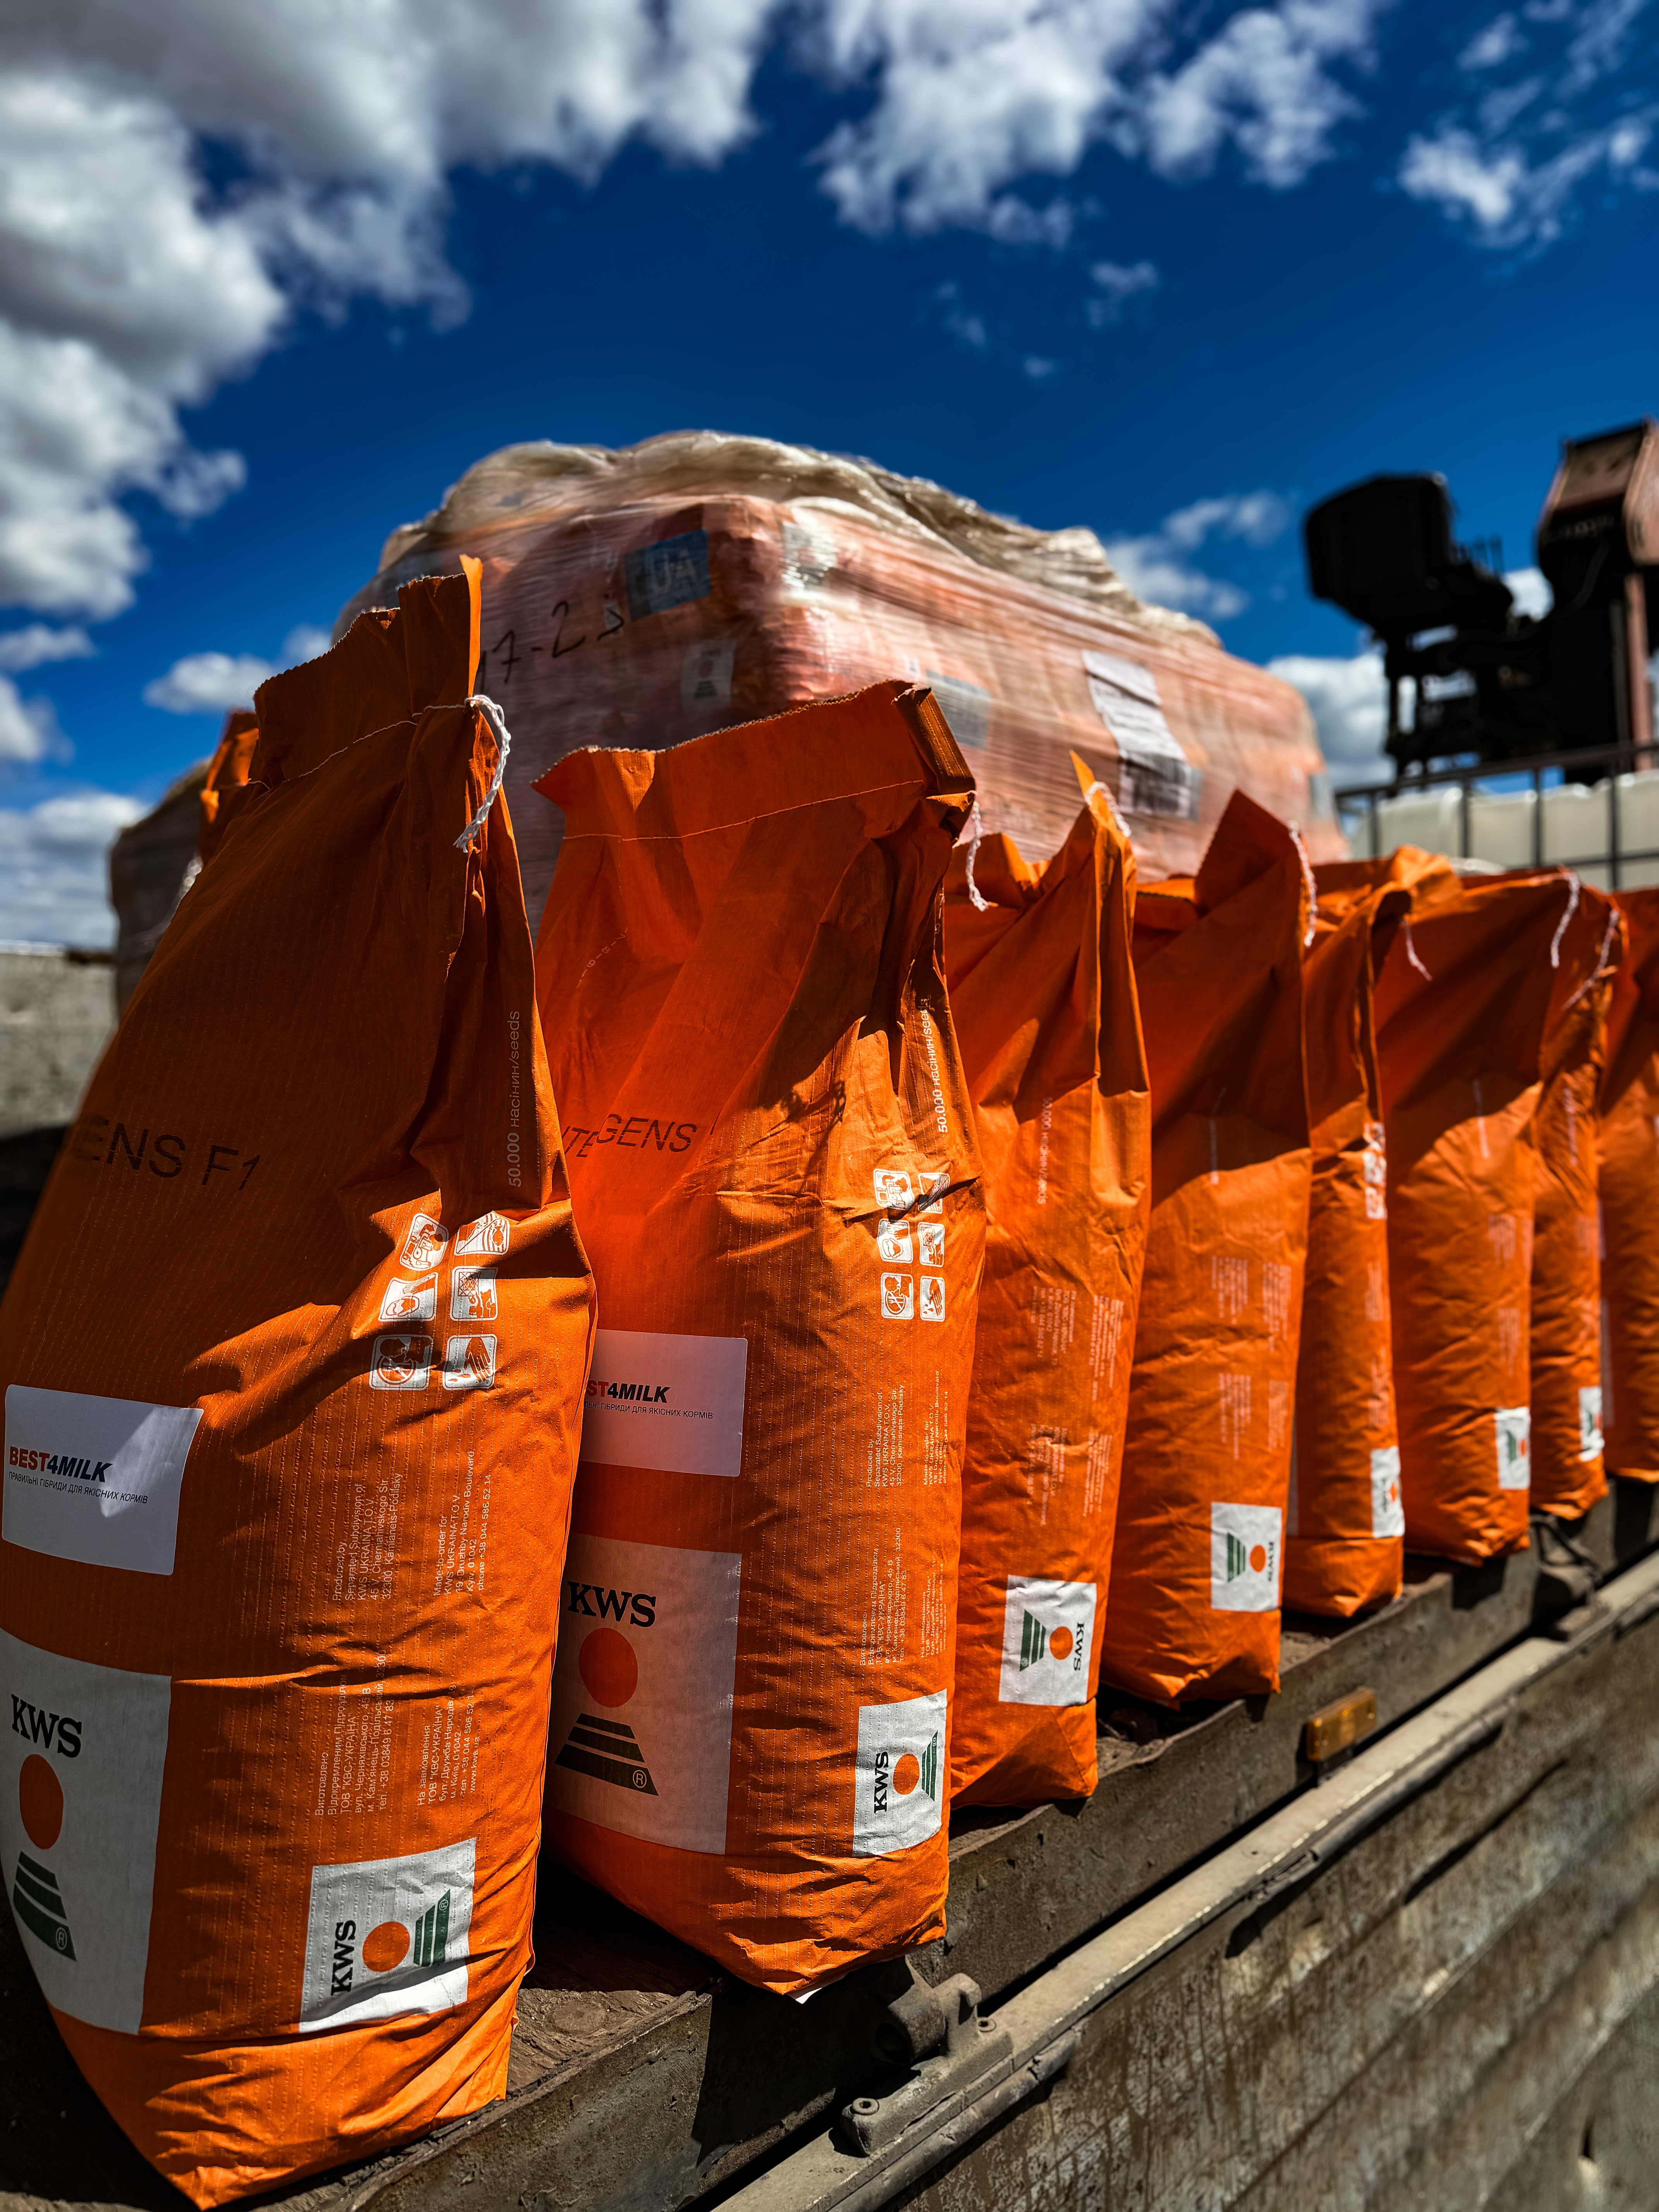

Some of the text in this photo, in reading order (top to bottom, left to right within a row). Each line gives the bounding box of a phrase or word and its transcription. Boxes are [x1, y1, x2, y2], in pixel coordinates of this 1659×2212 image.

[652, 548, 696, 594] UA
[507, 1011, 521, 1187] 50.000 насінин/seeds
[932, 1089, 948, 1133] 50.000
[201, 1145, 261, 1190] F1
[586, 1380, 670, 1403] ST4MILK
[877, 1392, 882, 1400] of
[601, 1403, 630, 1413] ГІБРИДИ
[649, 1407, 681, 1417] ЯКІСНИХ
[683, 1411, 713, 1419] КОРМІВ
[867, 1439, 874, 1448] by
[9, 1446, 113, 1482] BEST4MILK
[464, 1449, 476, 1497] Boulevard,
[484, 1475, 491, 1485] 14
[890, 1477, 895, 1487] 45
[9, 1471, 148, 1504] ПРАВИЛЬНІ ГІБРИДИ ДЛЯ ЯКІСНИХ КОРМІВ
[379, 1477, 388, 1493] Str.
[483, 1488, 491, 1499] 52
[372, 1496, 388, 1574] Cherniahivskogo
[385, 1473, 403, 1564] Kamianets-Podilsky
[460, 1500, 470, 1535] Narodiv
[345, 1484, 363, 1601] Separated Subdivision of
[359, 1527, 372, 1573] UKRAINA
[433, 1516, 447, 1595] Made-to-order for
[447, 1523, 458, 1568] UKRAINA
[457, 1538, 468, 1576] Druzhby
[333, 1542, 347, 1601] Produced by
[444, 1571, 453, 1594] KWS
[466, 1539, 477, 1592] Kyiv, 01042
[888, 1568, 893, 1578] 45
[902, 1570, 907, 1580] 83
[357, 1577, 368, 1600] KWS
[370, 1589, 379, 1600] 45
[567, 1581, 656, 1627] KWS
[902, 1583, 906, 1592] 47
[1073, 1622, 1084, 1671] KWS
[385, 1699, 394, 1711] 83
[448, 1685, 456, 1694] 19
[467, 1702, 474, 1714] 52
[11, 1694, 82, 1758] KWS
[368, 1802, 374, 1812] м.
[375, 1650, 386, 1678] 32300
[384, 1715, 393, 1726] 47
[340, 1713, 356, 1814] ТОВ "КВС-УКРАЇНА"
[355, 1793, 364, 1813] вул.
[361, 1698, 370, 1709] 45
[381, 1738, 391, 1767] 03849
[441, 1742, 451, 1779] Дружба
[450, 1788, 456, 1798] м.
[453, 1731, 461, 1760] 01042
[470, 1736, 480, 1793] www.kws.ua
[315, 1752, 328, 1815] Виготовлено
[328, 1737, 342, 1815] Відокремленим
[380, 1771, 388, 1788] +38
[428, 1782, 436, 1804] ТОВ
[439, 1781, 448, 1801] бул.
[874, 1751, 889, 1814] KWS
[417, 1792, 426, 1805] На
[331, 1920, 356, 1996] KWS
